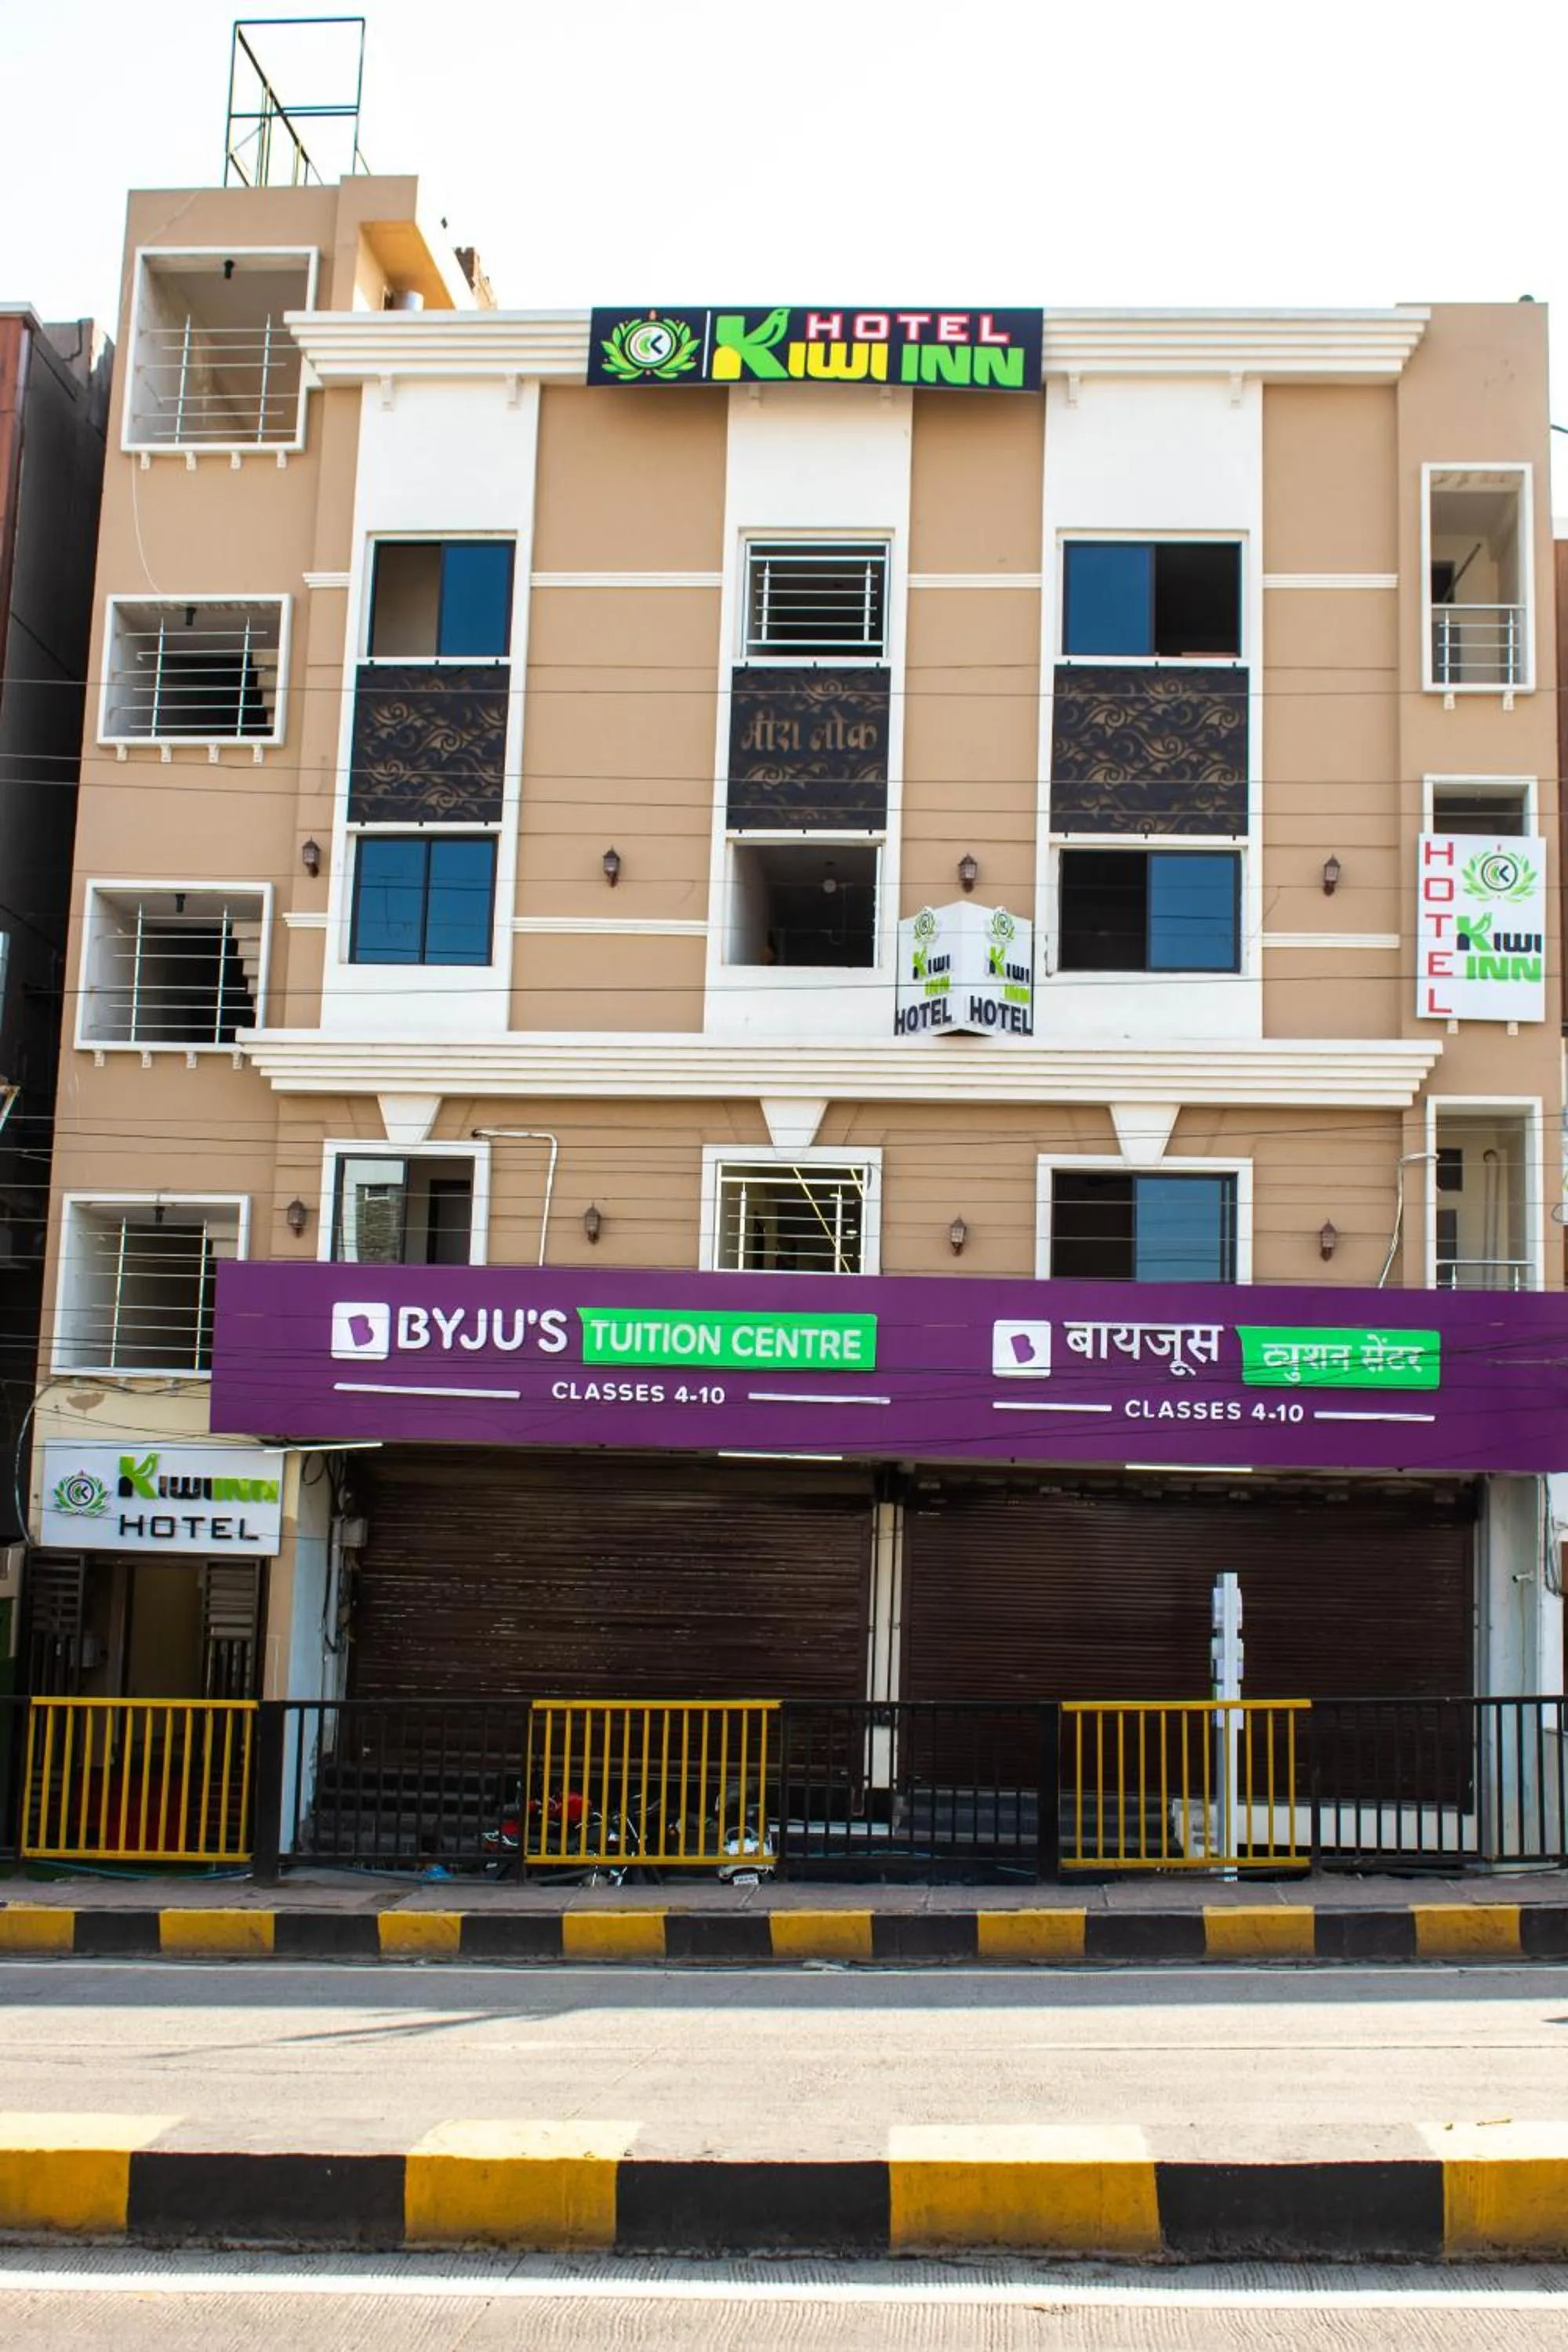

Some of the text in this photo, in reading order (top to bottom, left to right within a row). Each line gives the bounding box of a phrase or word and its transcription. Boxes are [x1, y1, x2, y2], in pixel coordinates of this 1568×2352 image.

[711, 308, 1024, 386] KIWI INN
[805, 313, 1011, 343] HOTEL
[1424, 841, 1454, 1013] HOTEL
[1465, 955, 1542, 982] INN
[894, 997, 952, 1036] HOTEL
[970, 996, 1033, 1036] HOTEL
[397, 1306, 568, 1353] BYJU'S
[590, 1319, 722, 1356] TUITION
[731, 1325, 862, 1360] CENTRE
[1063, 1321, 1224, 1376] बायजूस
[1359, 1334, 1425, 1373] सेंटर
[552, 1381, 725, 1404] CLASSES 4-10
[1125, 1399, 1304, 1422] CLASSES 4-10
[119, 1514, 260, 1541] HOTEL
